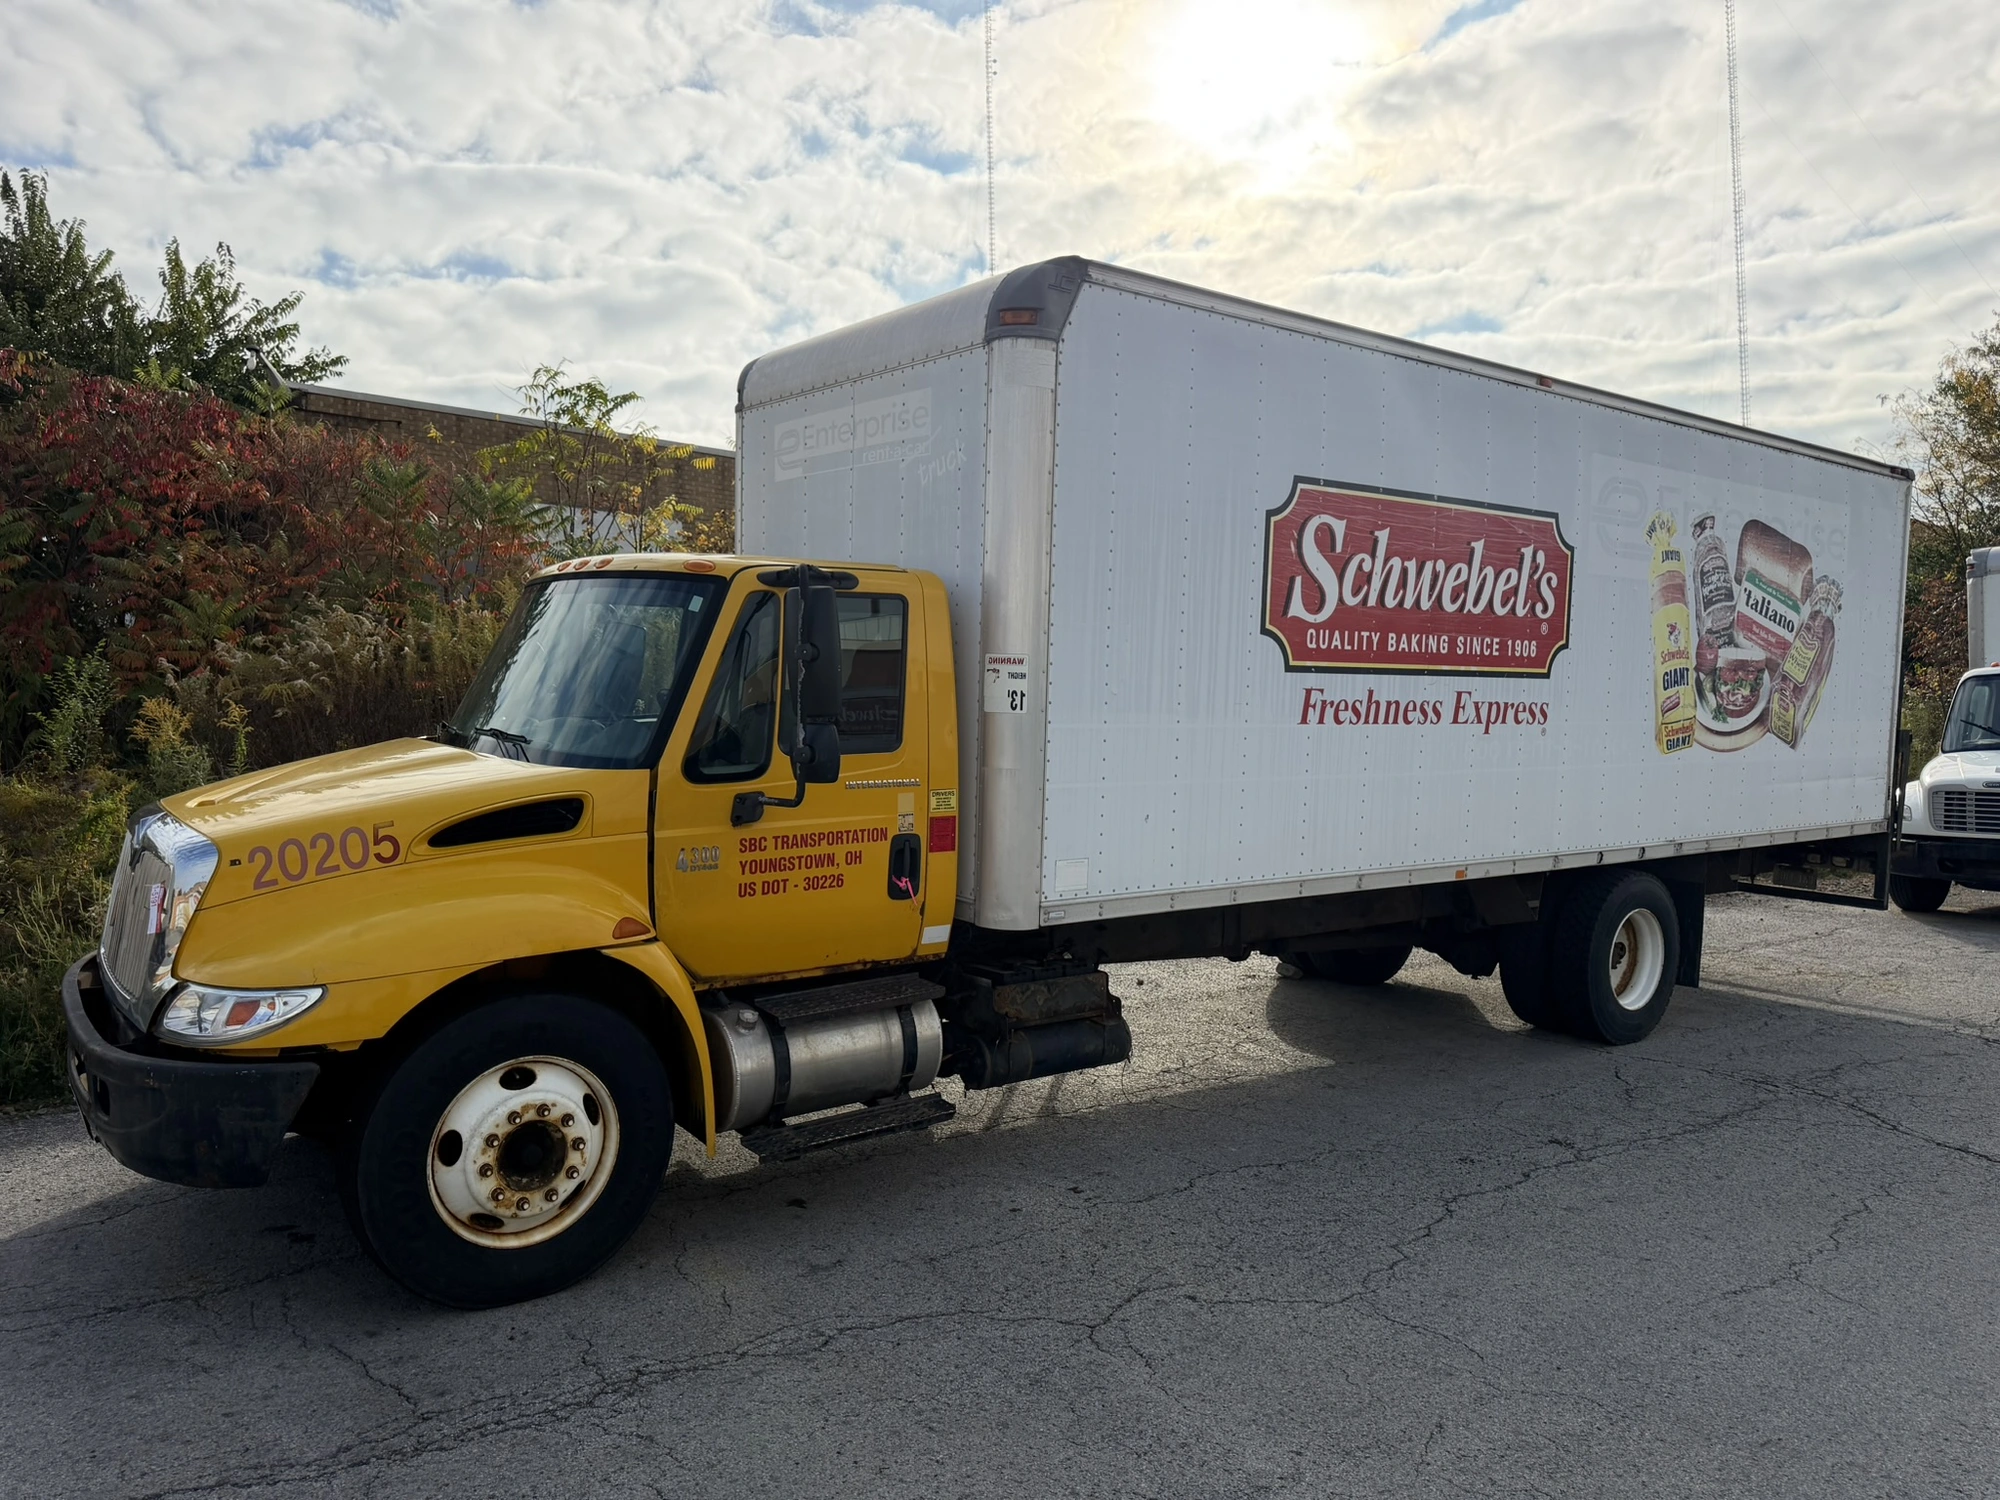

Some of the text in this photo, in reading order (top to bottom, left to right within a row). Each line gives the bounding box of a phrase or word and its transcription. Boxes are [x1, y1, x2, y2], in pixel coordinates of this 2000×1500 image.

[803, 403, 929, 450] Enterprise
[918, 439, 968, 485] truck
[1286, 514, 1558, 624] Schwebel's
[1306, 628, 1538, 658] QUALITY BAKING SINCE 1906
[1662, 667, 1690, 691] GIANT
[1297, 686, 1550, 735] Freshness Express
[1666, 733, 1692, 751] GIANT
[845, 778, 922, 790] INTERNATIONAL
[932, 790, 956, 798] DRIVERS
[738, 827, 889, 854] SBC TRANSPORTATION
[247, 820, 401, 891] 20205
[675, 845, 720, 873] 4300
[738, 850, 863, 876] YOUNGSTOWN, OH
[738, 881, 757, 898] US
[761, 879, 790, 896] DOT
[803, 873, 845, 892] 30226
